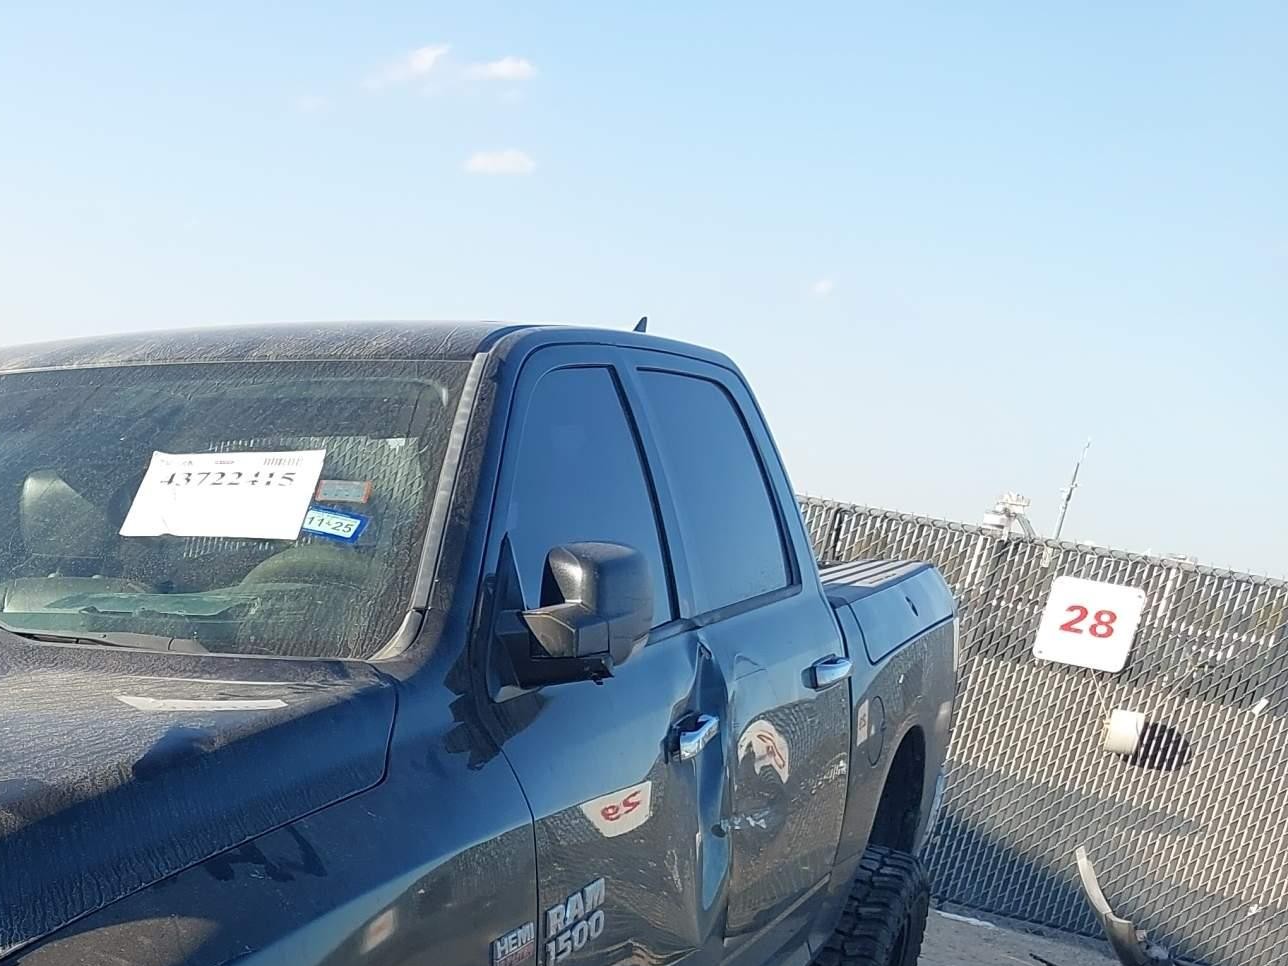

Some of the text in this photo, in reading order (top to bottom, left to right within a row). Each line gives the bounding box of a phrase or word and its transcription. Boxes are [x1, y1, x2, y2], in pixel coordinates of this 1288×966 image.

[160, 471, 297, 487] 43722415
[1058, 605, 1118, 638] 28
[545, 877, 606, 938] RAM
[495, 921, 535, 960] HEMI
